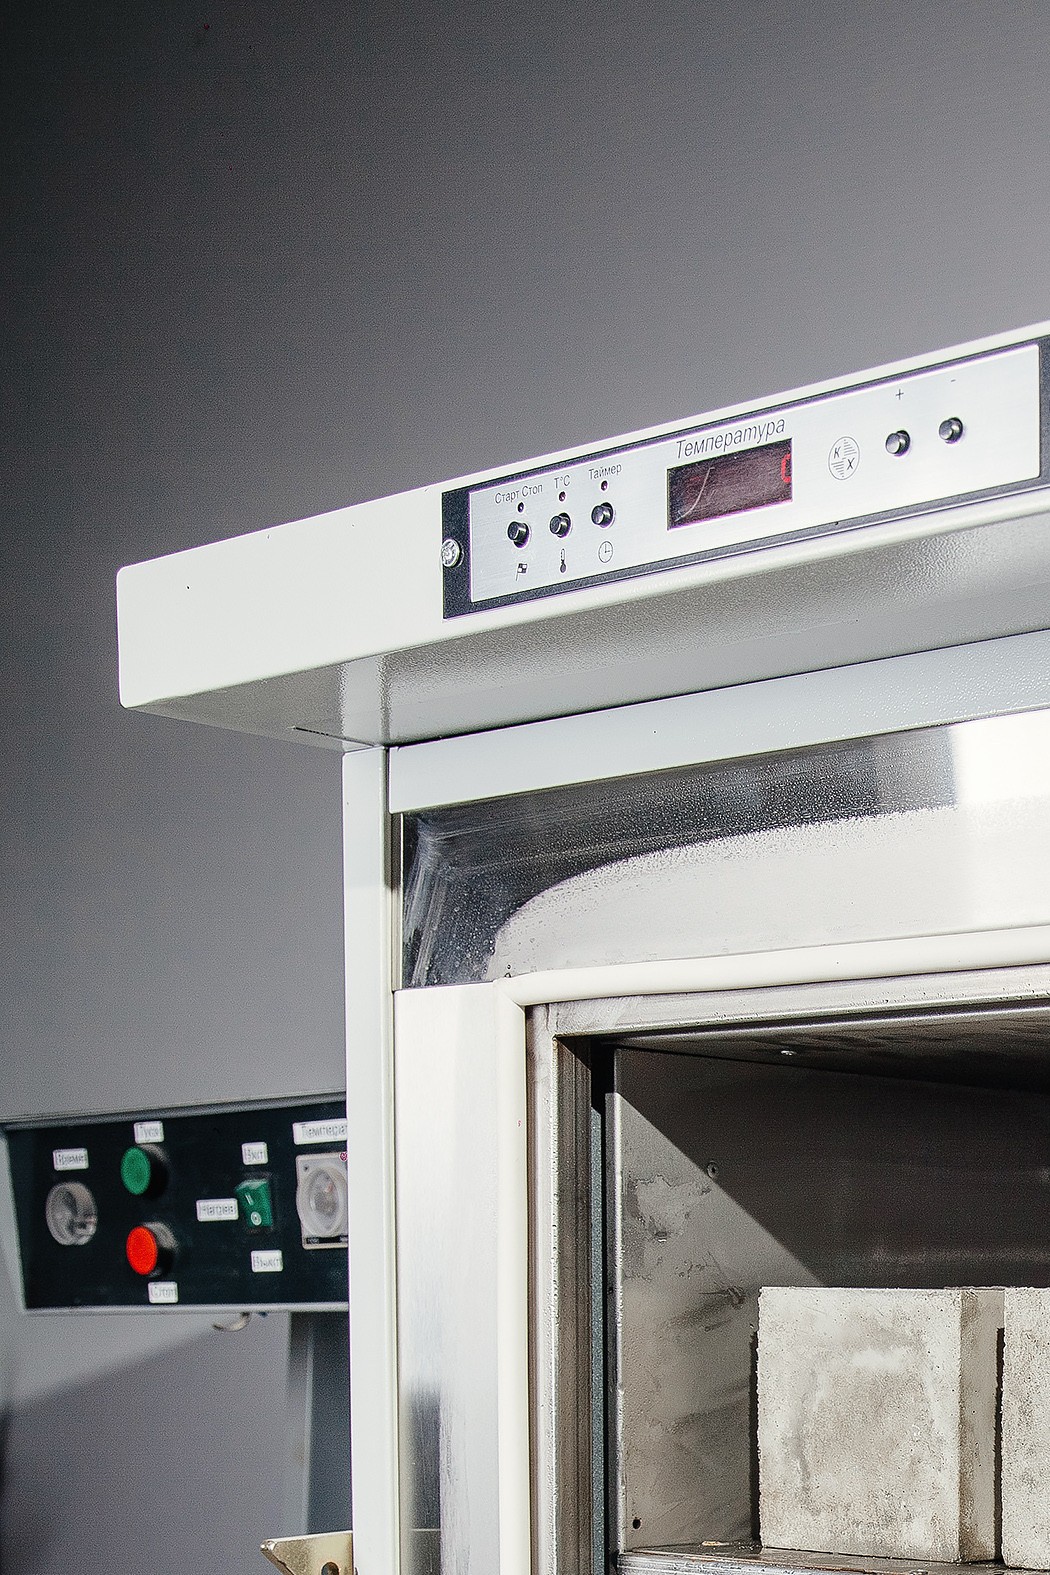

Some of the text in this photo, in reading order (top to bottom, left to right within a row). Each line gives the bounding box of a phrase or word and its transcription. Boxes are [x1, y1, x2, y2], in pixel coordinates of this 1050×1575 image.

[676, 418, 785, 459] Температура
[588, 464, 622, 480] Таймер
[494, 484, 543, 504] Старт Стоп
